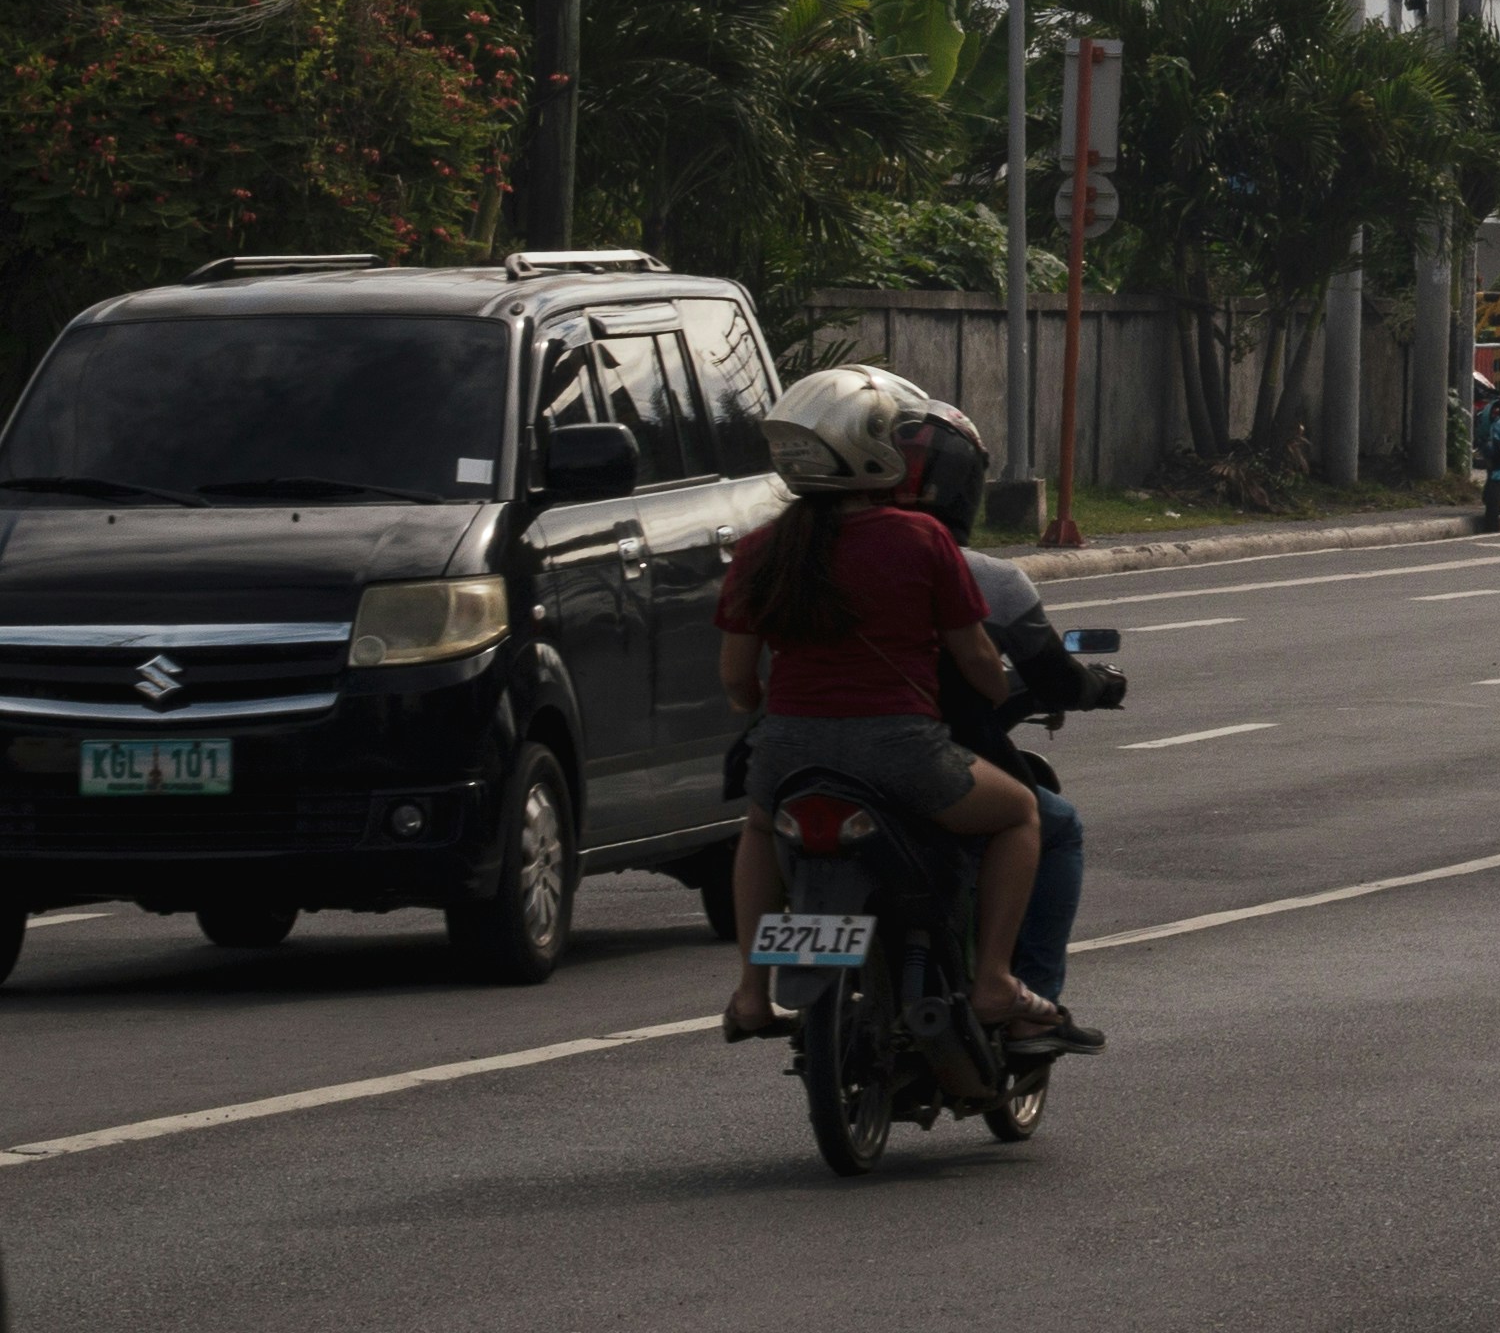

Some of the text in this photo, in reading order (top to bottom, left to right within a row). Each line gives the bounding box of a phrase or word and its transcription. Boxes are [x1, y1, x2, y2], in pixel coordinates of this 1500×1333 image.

[92, 748, 217, 779] KGL 101
[757, 925, 867, 953] 527LIF
